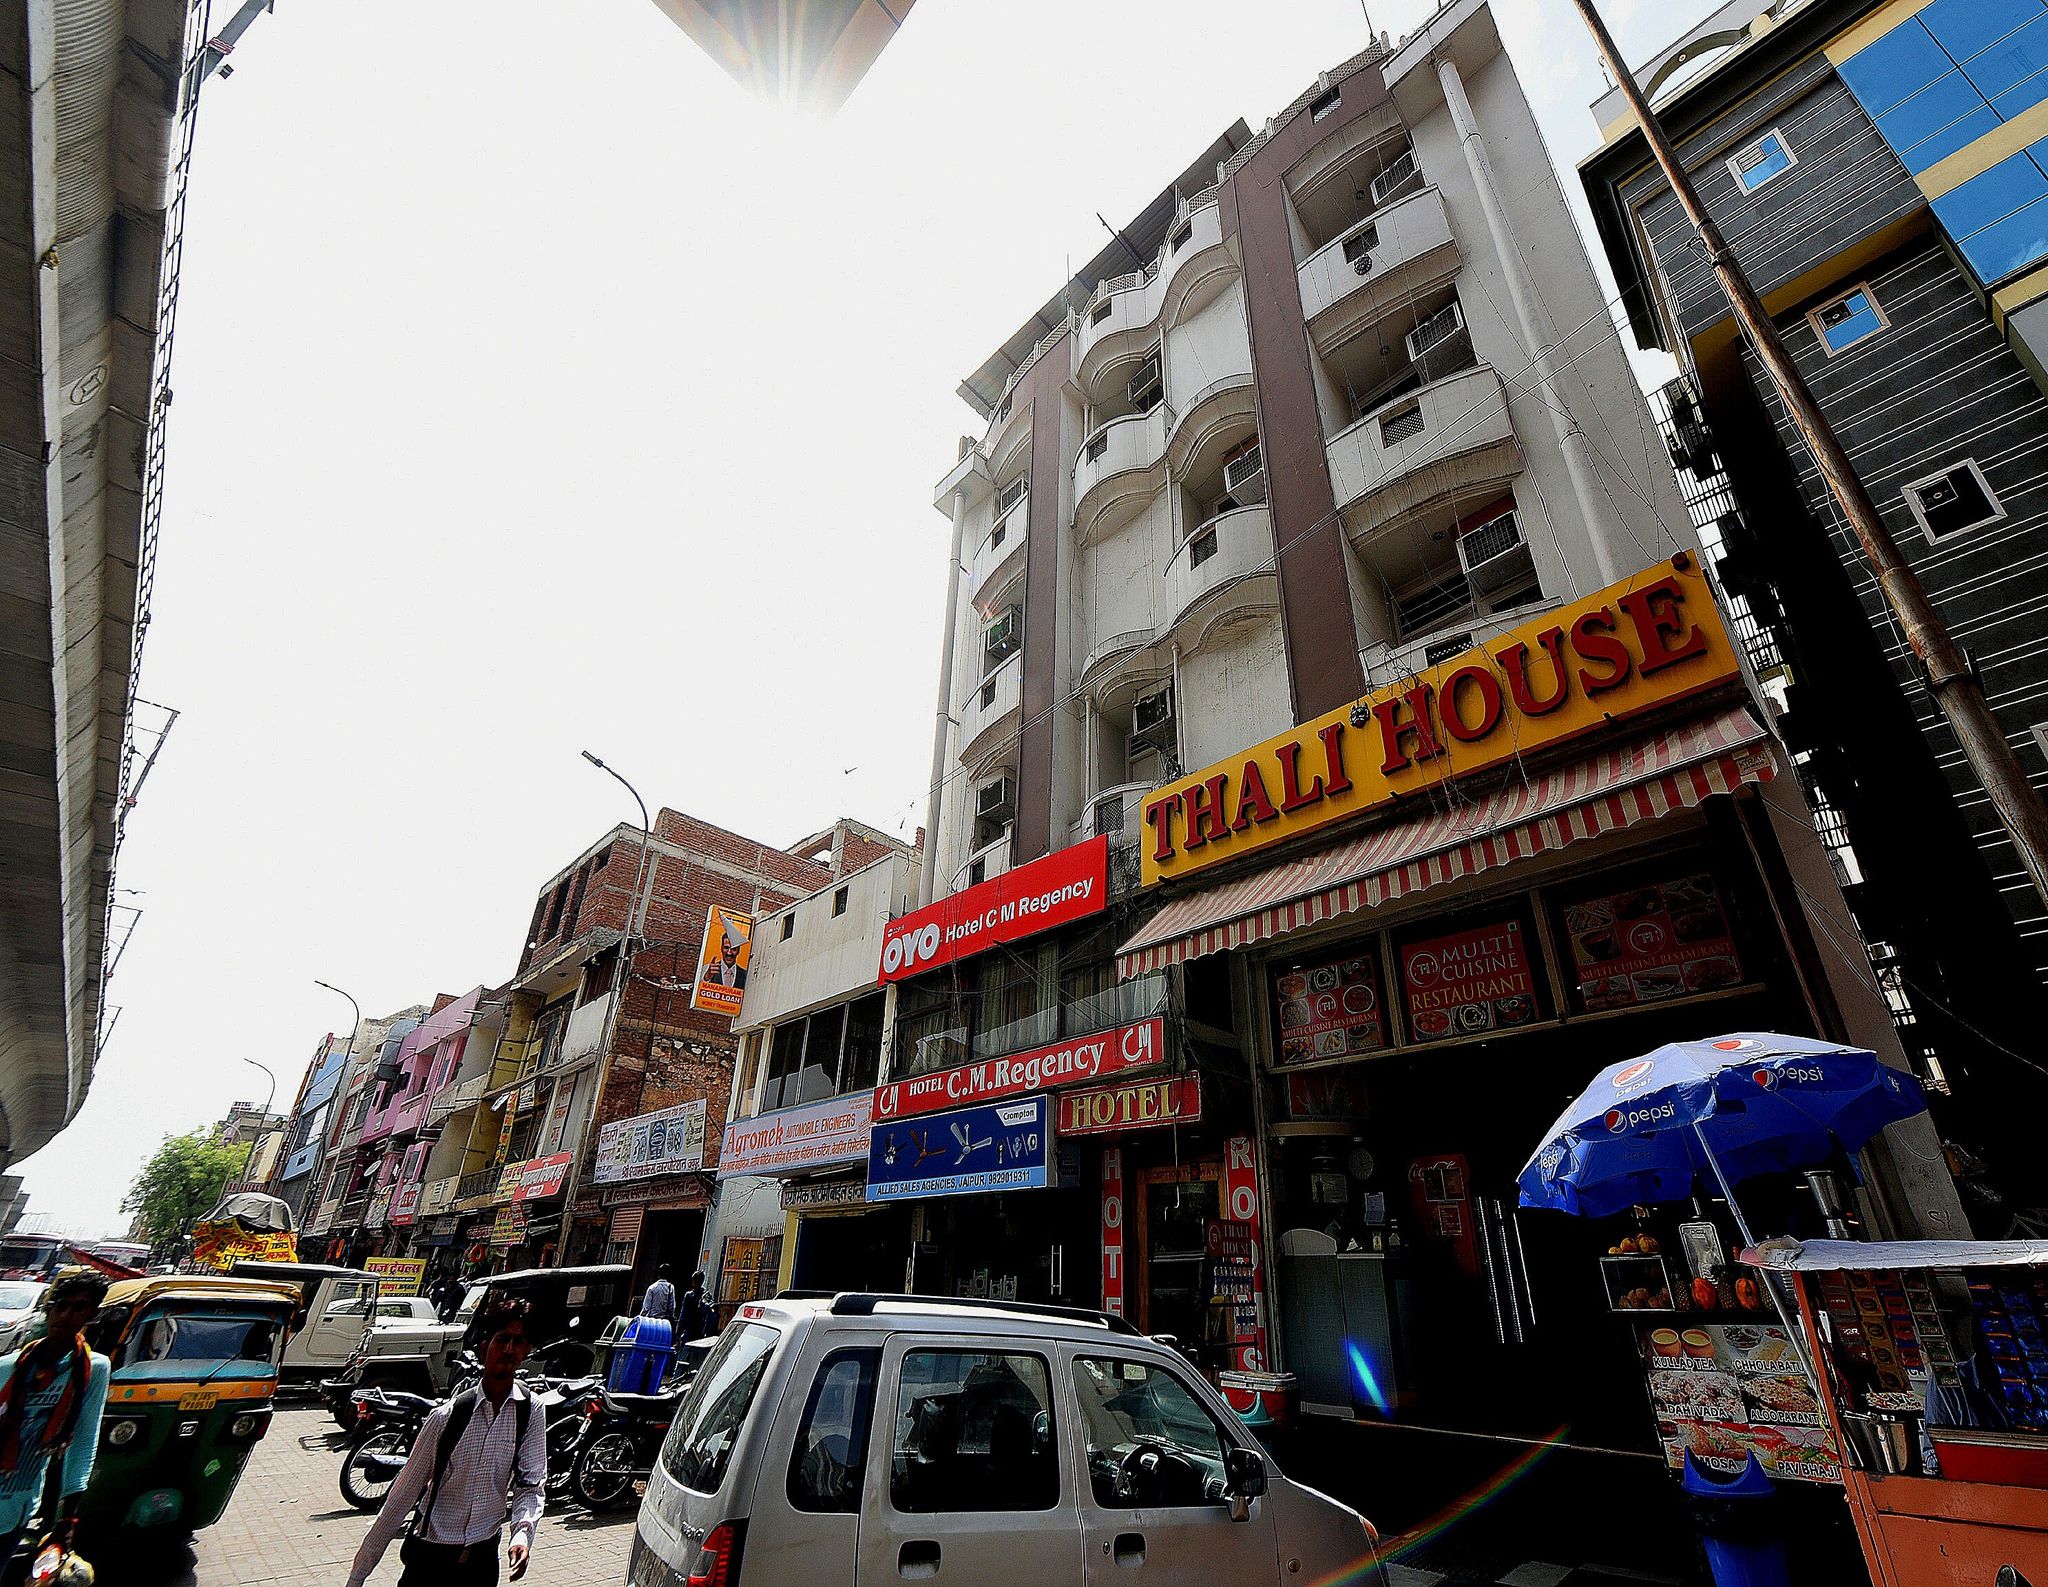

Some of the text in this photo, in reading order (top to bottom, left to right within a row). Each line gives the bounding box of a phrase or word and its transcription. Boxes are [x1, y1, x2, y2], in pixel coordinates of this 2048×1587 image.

[1146, 575, 1707, 862] THALI HOUSE
[883, 923, 939, 973] OYO
[946, 915, 983, 943] Hotel
[986, 910, 997, 928] C
[1000, 901, 1015, 923] M
[1018, 877, 1094, 917] Regency
[1442, 935, 1514, 963] MULTI
[1442, 953, 1518, 981] CUISINE
[701, 990, 740, 1004] GOLD LOAN
[1412, 973, 1527, 1010] RESTAURANT
[1282, 1012, 1377, 1039] MULTI CUISINE RESTAURANT
[909, 1077, 944, 1097] HOTEL
[1616, 1078, 1651, 1098] pepsi
[1003, 1109, 1034, 1121] Crompton
[1071, 1086, 1181, 1129] HOTEL
[1629, 1100, 1675, 1128] pepsi
[723, 1117, 784, 1158] Agromek
[786, 1120, 818, 1139] AUTOMOBILE
[821, 1113, 856, 1134] ENGINEERS
[877, 1184, 898, 1195] ALLIED
[900, 1182, 920, 1194] SALES
[921, 1178, 957, 1192] AGENCIES,
[959, 1174, 986, 1187] JAIPUR,
[1104, 1149, 1122, 1318] HOTE
[1652, 1356, 1717, 1371] KULLAD TEA
[1733, 1360, 1805, 1373] CHHOLA BATU
[1667, 1404, 1728, 1419] DAHI VADA
[1750, 1409, 1830, 1426] ALOO PARANTH
[1702, 1455, 1738, 1470] MOSA
[1778, 1461, 1841, 1479] PAV BHAJI
